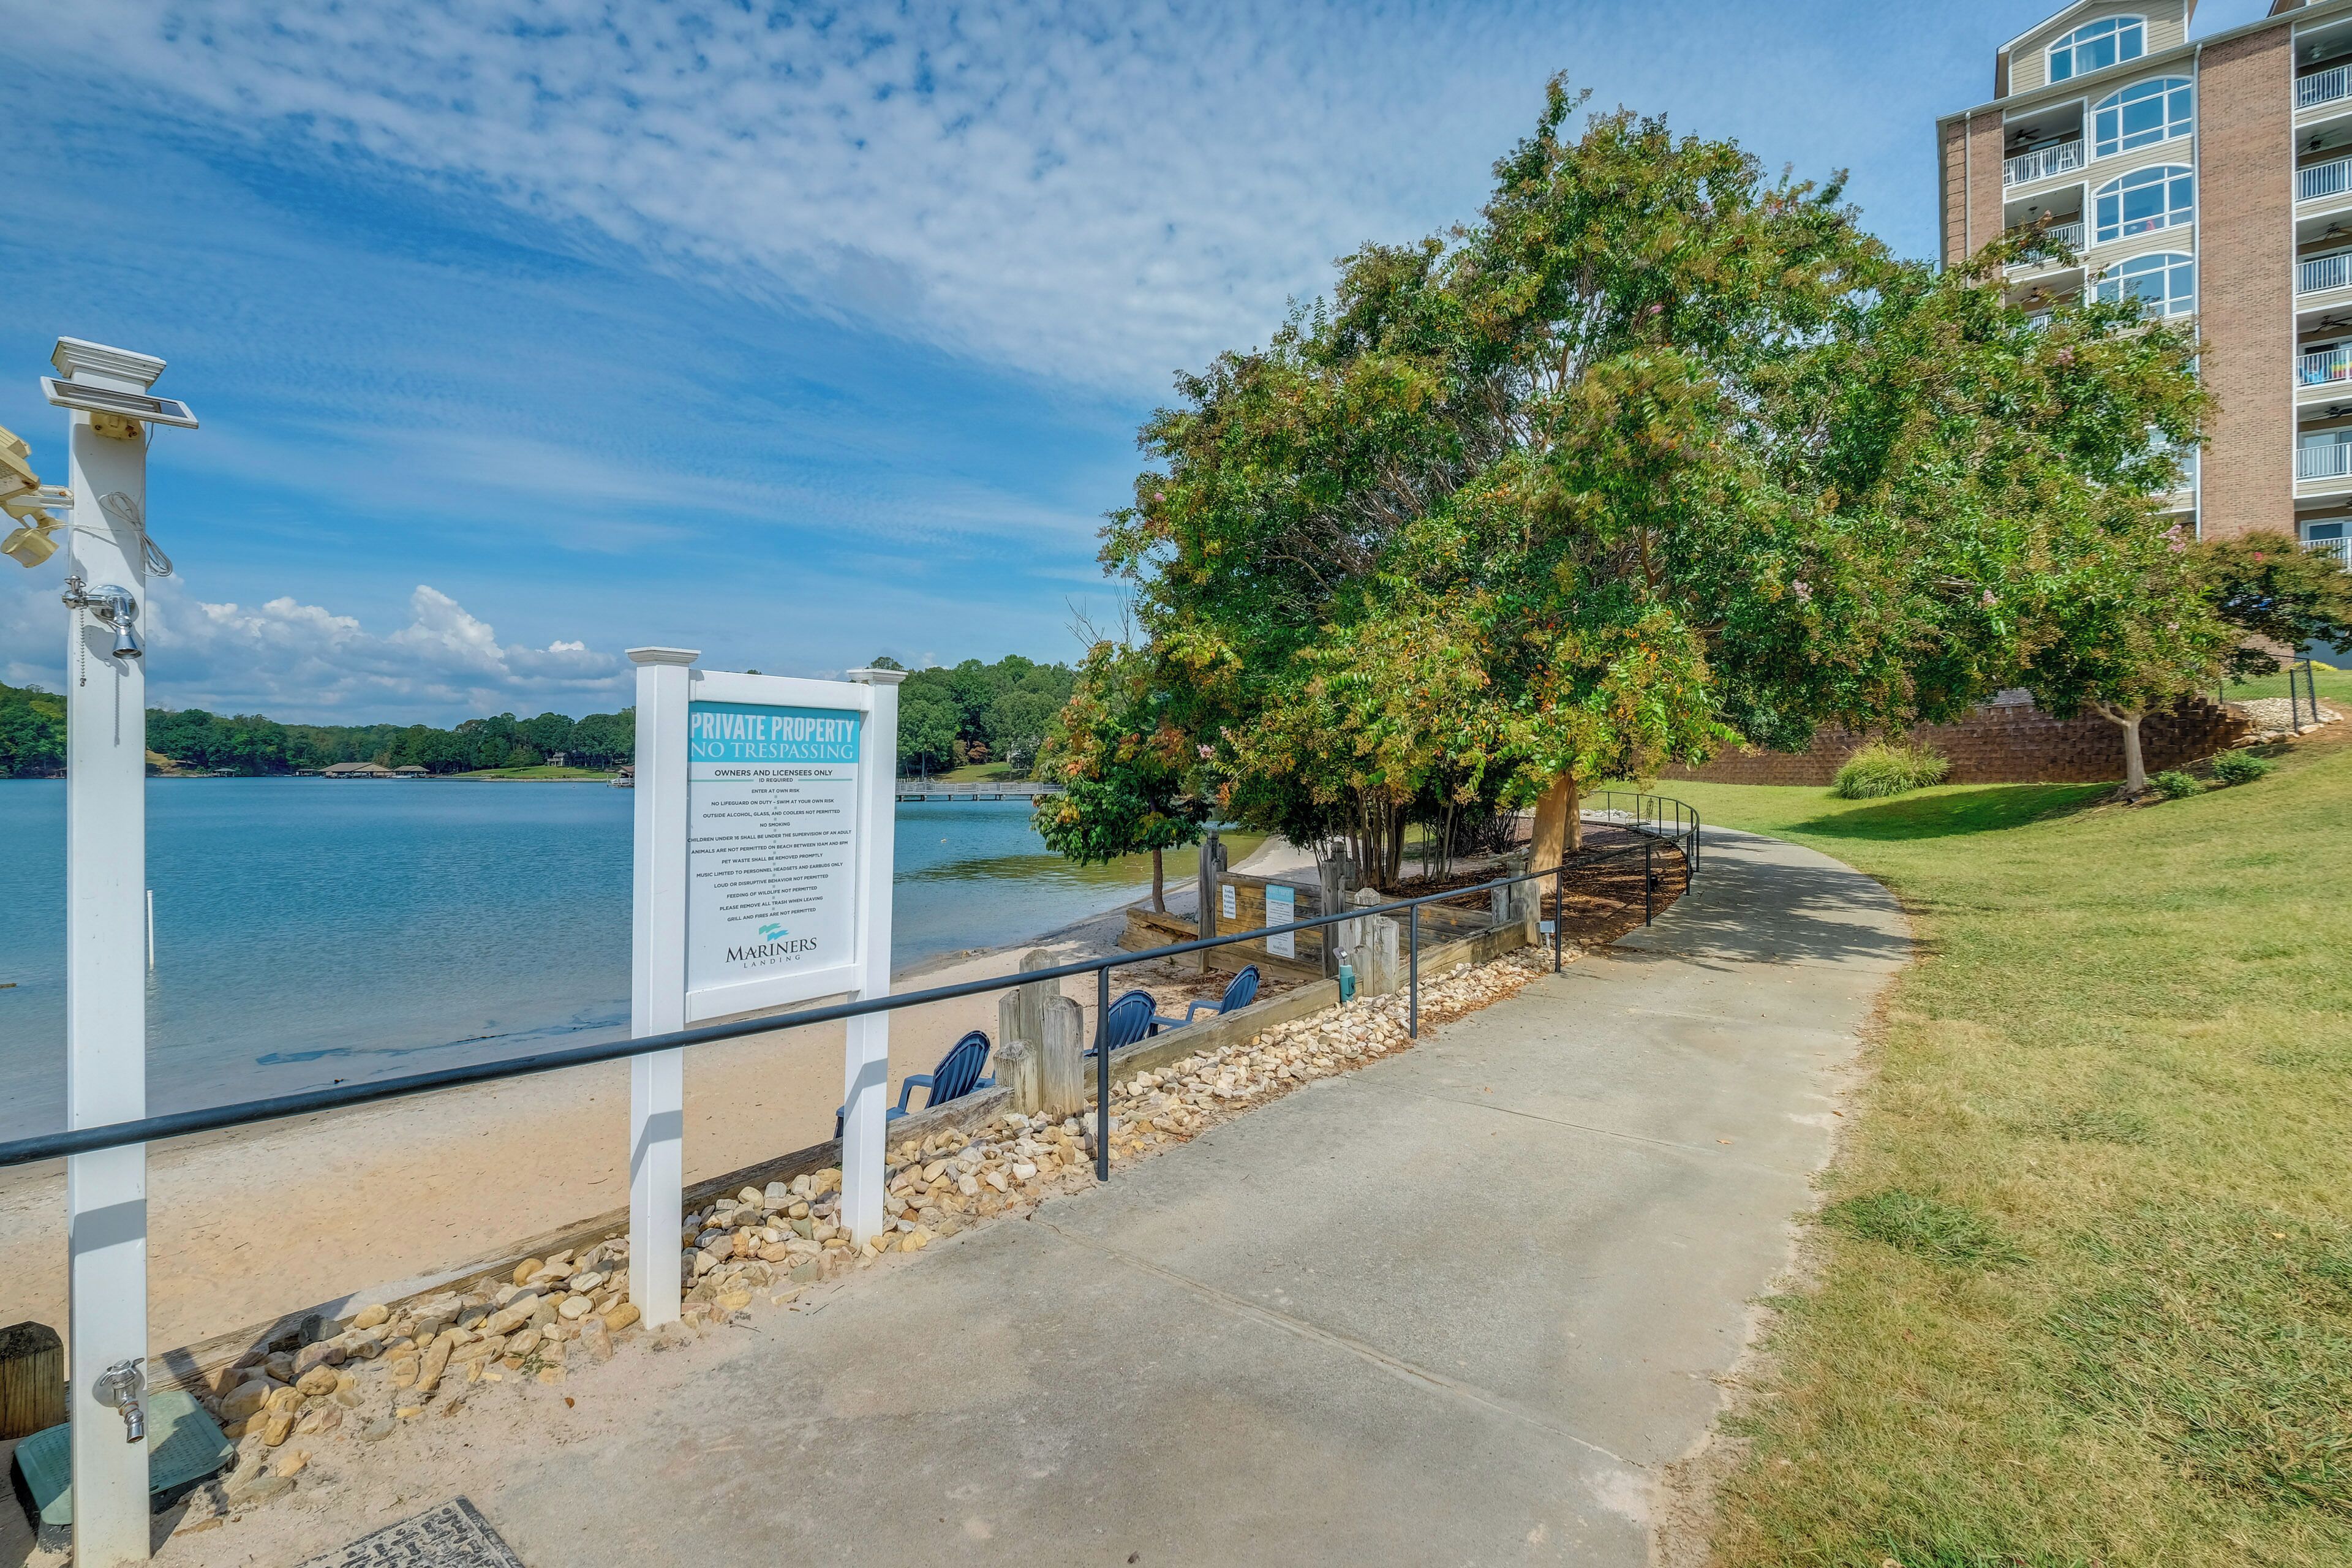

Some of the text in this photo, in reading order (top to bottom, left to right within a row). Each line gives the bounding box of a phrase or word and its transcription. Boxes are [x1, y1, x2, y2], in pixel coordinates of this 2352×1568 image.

[690, 712, 854, 743] PRIVATE PROPERTY
[691, 742, 853, 759] NO TRESPASSING
[725, 937, 817, 963] MARINERS
[744, 954, 801, 968] LANDING
